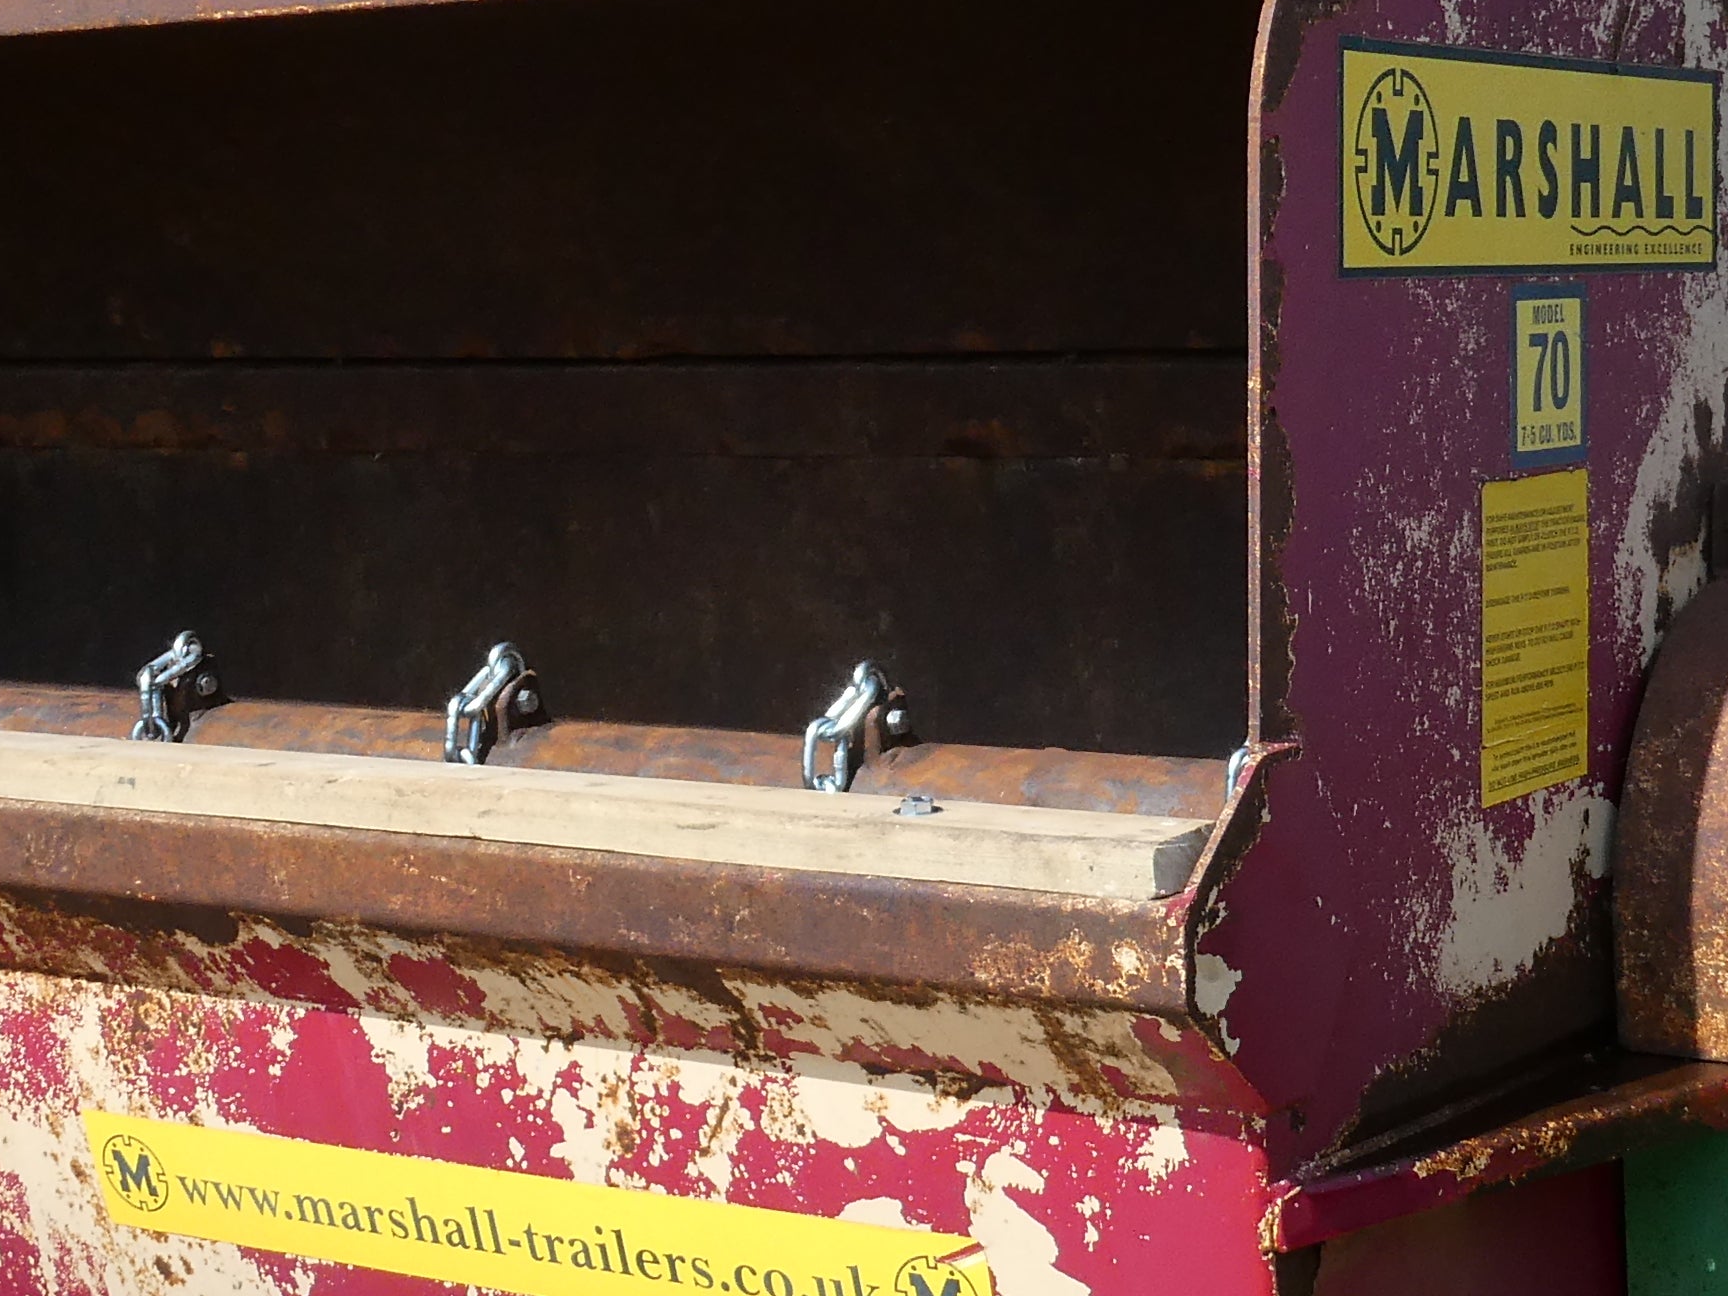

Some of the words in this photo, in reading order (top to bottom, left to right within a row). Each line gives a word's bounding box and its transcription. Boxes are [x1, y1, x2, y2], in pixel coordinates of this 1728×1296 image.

[1371, 106, 1704, 220] MARSHALL
[1570, 243, 1639, 256] ENGINEERING
[1644, 242, 1702, 255] EXCELLENCE
[1532, 304, 1565, 324] MODEL
[1529, 331, 1570, 412] 70
